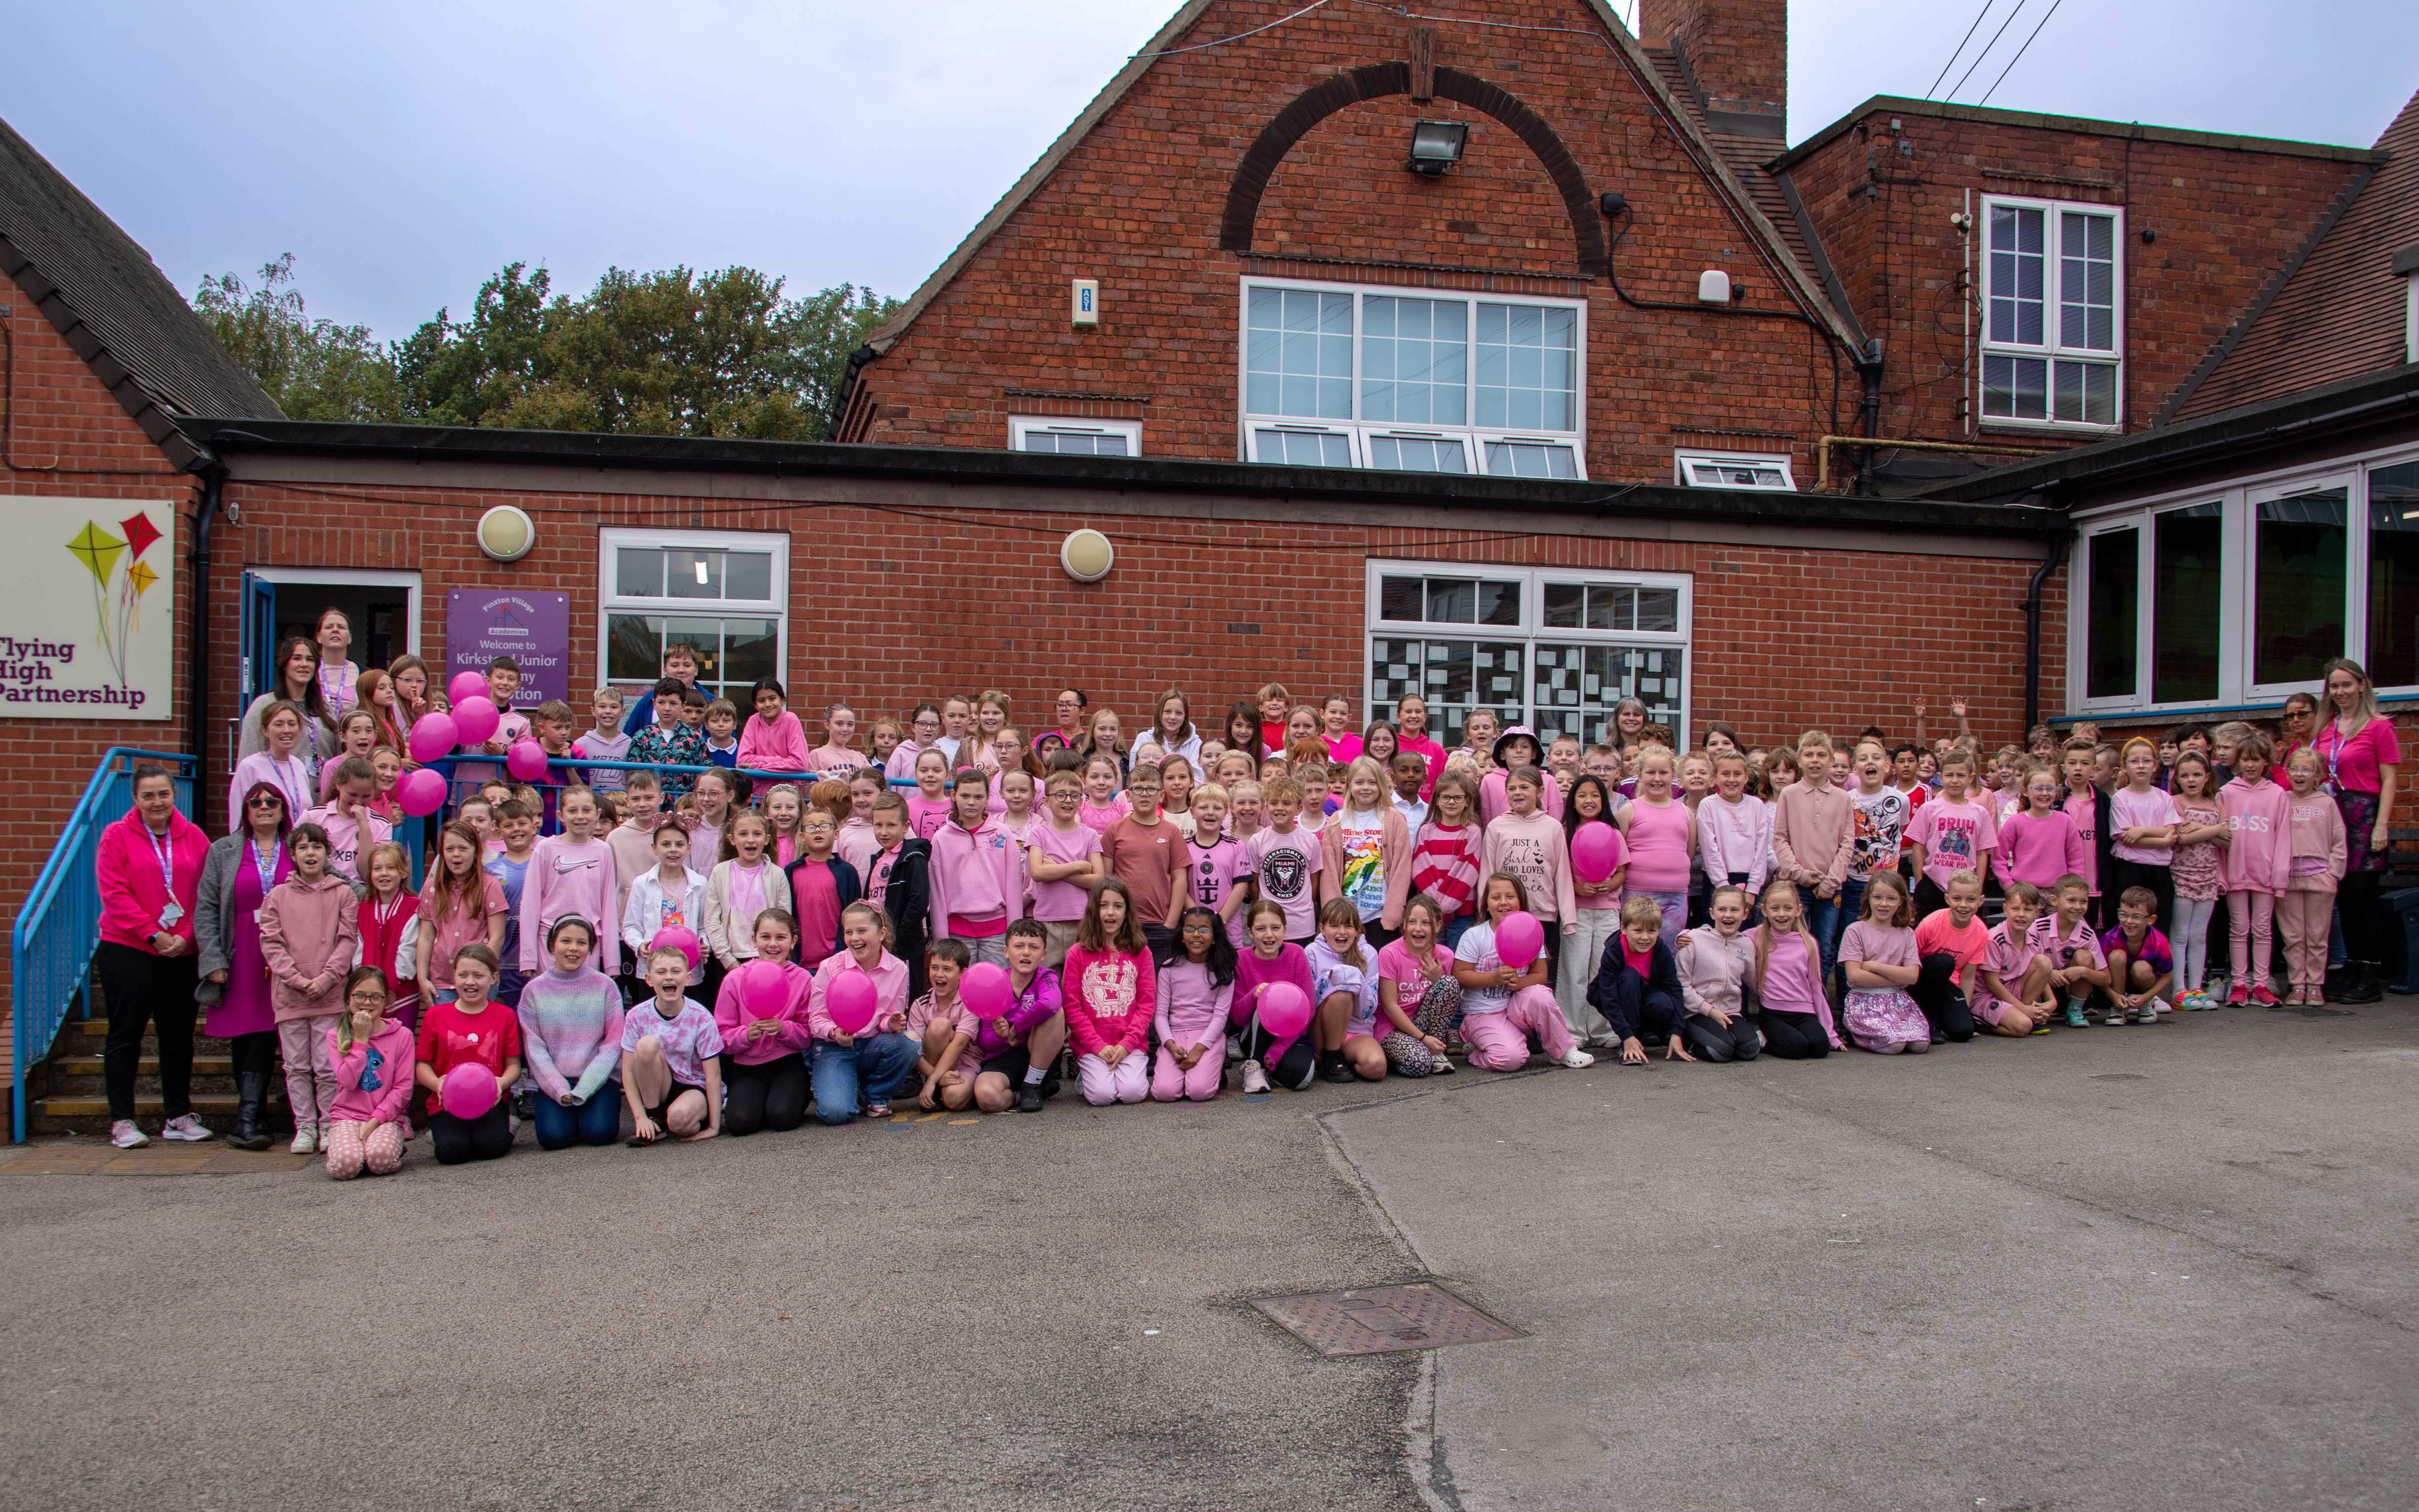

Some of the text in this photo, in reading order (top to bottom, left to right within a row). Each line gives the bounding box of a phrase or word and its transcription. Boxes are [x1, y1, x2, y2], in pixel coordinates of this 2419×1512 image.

[483, 596, 534, 613] Pinxton Village
[480, 640, 524, 650] Welcome
[456, 653, 558, 666] Kirkstd Junior
[2290, 806, 2324, 817] ANGELES
[1511, 838, 1530, 847] JUST
[1264, 849, 1301, 869] NTERNACIONAL
[1521, 866, 1545, 874] LOVES
